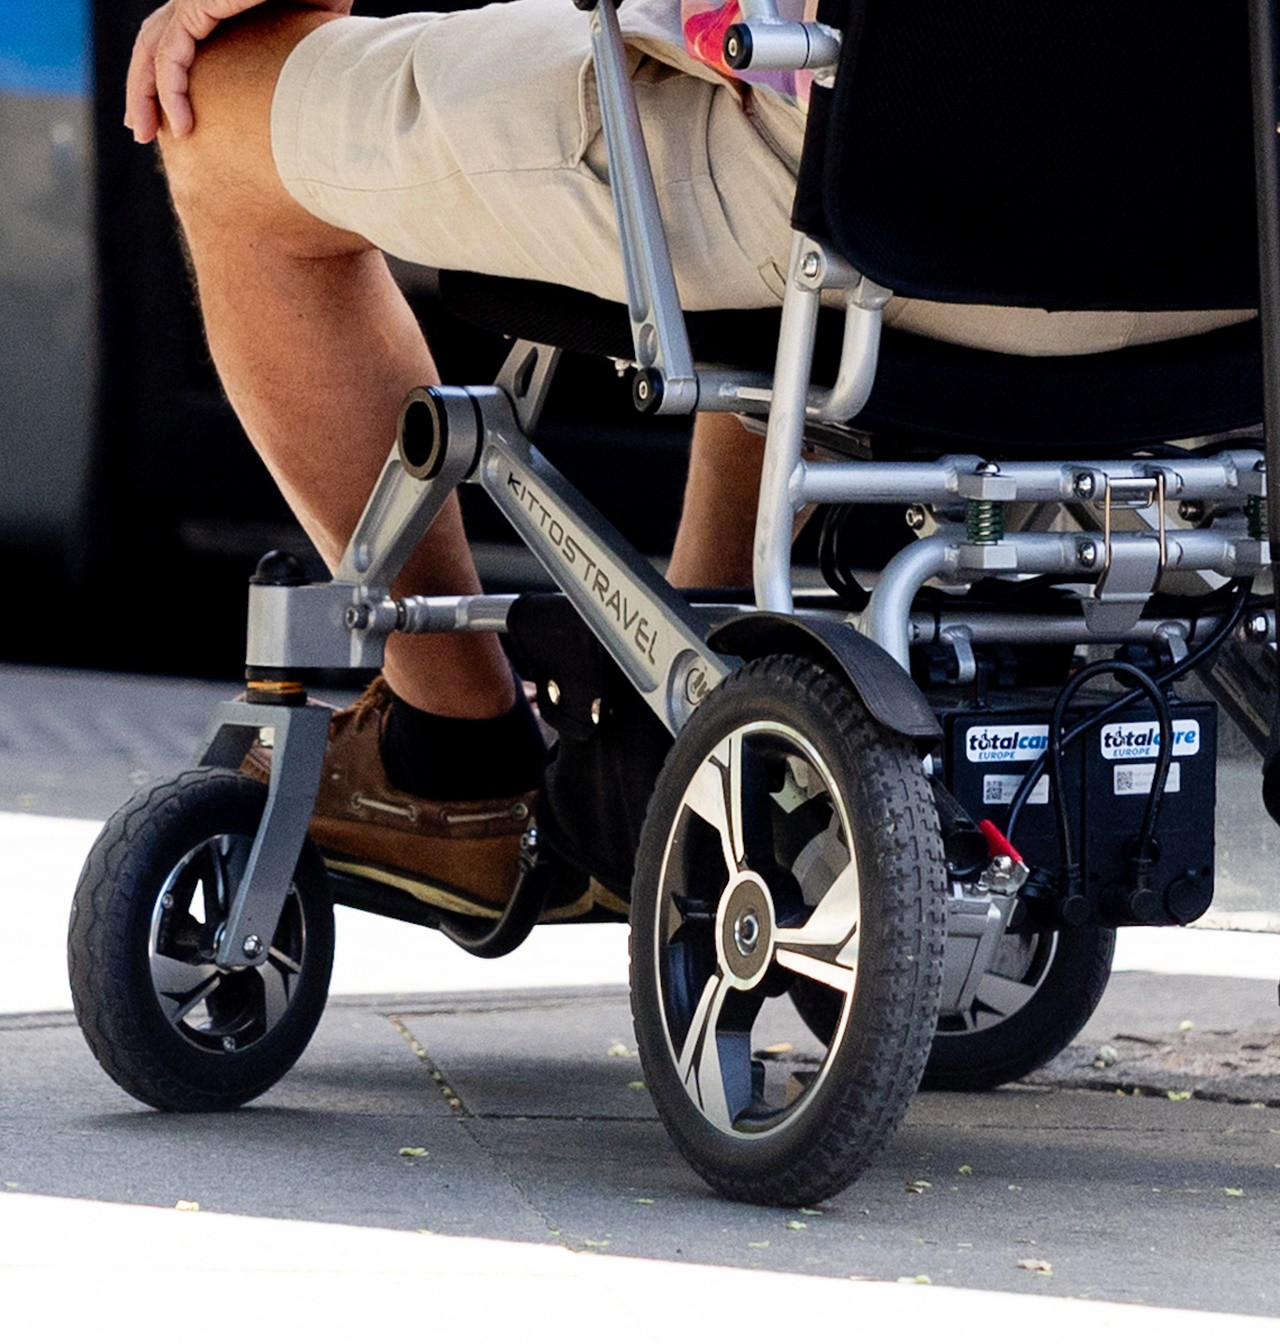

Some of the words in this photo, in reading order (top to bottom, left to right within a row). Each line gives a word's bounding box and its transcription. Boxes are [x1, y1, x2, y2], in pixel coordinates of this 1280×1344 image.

[508, 471, 657, 665] KITTOSTRAVEL
[969, 729, 1049, 750] totalcar
[1104, 726, 1196, 748] totalcre
[978, 751, 1015, 760] EUROPE
[1113, 748, 1150, 758] EUROPE
